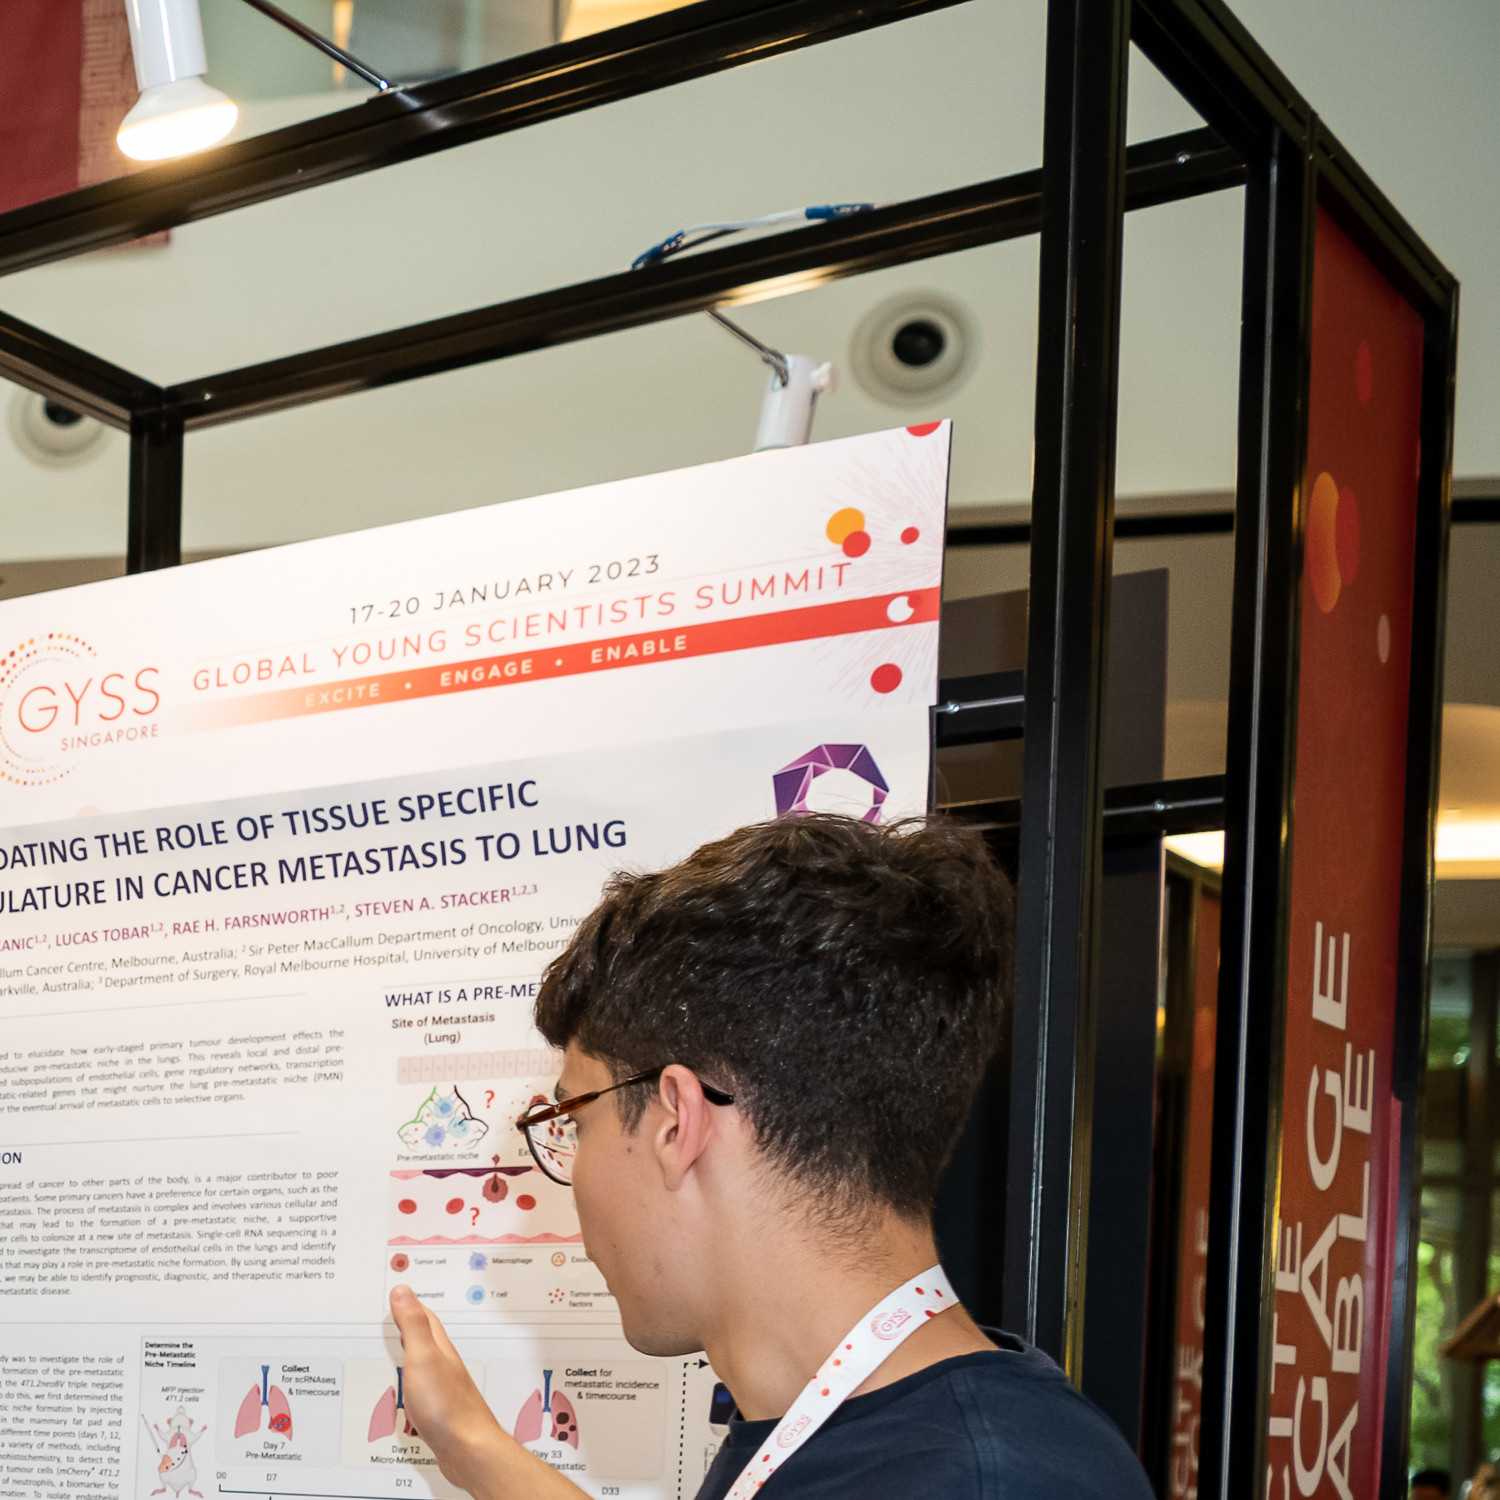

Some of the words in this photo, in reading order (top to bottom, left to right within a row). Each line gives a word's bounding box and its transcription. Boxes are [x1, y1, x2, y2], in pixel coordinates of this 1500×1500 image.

[349, 596, 421, 625] 17-20
[432, 568, 574, 611] JANUARY
[587, 553, 660, 585] 2023
[192, 652, 316, 692] GLOBAL
[331, 629, 447, 669] YOUNG
[464, 591, 676, 648] SCIENTISTS
[695, 561, 853, 610] SUMMIT
[301, 681, 381, 712] EXCITE
[439, 658, 533, 688] ENGAGE
[590, 634, 687, 664] ENABLE
[19, 667, 159, 733] GYSS
[61, 724, 159, 751] SINGAPORE
[93, 829, 149, 859] THE
[155, 819, 229, 852] ROLE
[236, 813, 275, 842] OF
[281, 799, 390, 836] TISSUE
[397, 779, 539, 823] SPECIFIC
[115, 875, 144, 902] IN
[153, 861, 269, 898] CANCER
[277, 838, 467, 885] METASTASIS
[474, 832, 521, 862] TO
[532, 819, 627, 857] LUNG
[55, 930, 99, 948] LUCAS
[172, 919, 201, 936] RAE
[204, 918, 220, 933] H.
[354, 898, 414, 918] STEVEN
[418, 896, 436, 911] A.
[25, 964, 65, 977] Cancer
[66, 961, 108, 974] Centre,
[248, 944, 265, 958] Sir
[267, 942, 301, 955] Peter
[303, 935, 374, 952] MacCallum
[377, 927, 457, 946] Department
[460, 923, 475, 938] of
[104, 972, 175, 989] Department
[177, 968, 191, 982] of
[243, 961, 277, 977] Royal
[280, 958, 350, 973] Melbourne
[413, 946, 481, 962] University
[483, 941, 498, 956] of
[501, 938, 569, 958] Melbourn
[385, 990, 433, 1007] WHAT
[438, 990, 452, 1003] IS
[457, 989, 468, 1001] A
[474, 982, 541, 1000] PRE-ME
[392, 1018, 414, 1029] Site
[416, 1017, 429, 1027] of
[432, 1012, 495, 1025] Metastasis
[424, 1031, 461, 1045] (Lung)
[282, 1365, 309, 1373] Collect
[282, 1375, 292, 1383] for
[295, 1376, 336, 1385] scRNAseq
[565, 1368, 597, 1377] Collect
[599, 1369, 612, 1377] for
[565, 1380, 613, 1388] metastatic
[615, 1381, 659, 1389] incidence
[585, 1392, 636, 1401] timecourse
[396, 1479, 412, 1487] D12
